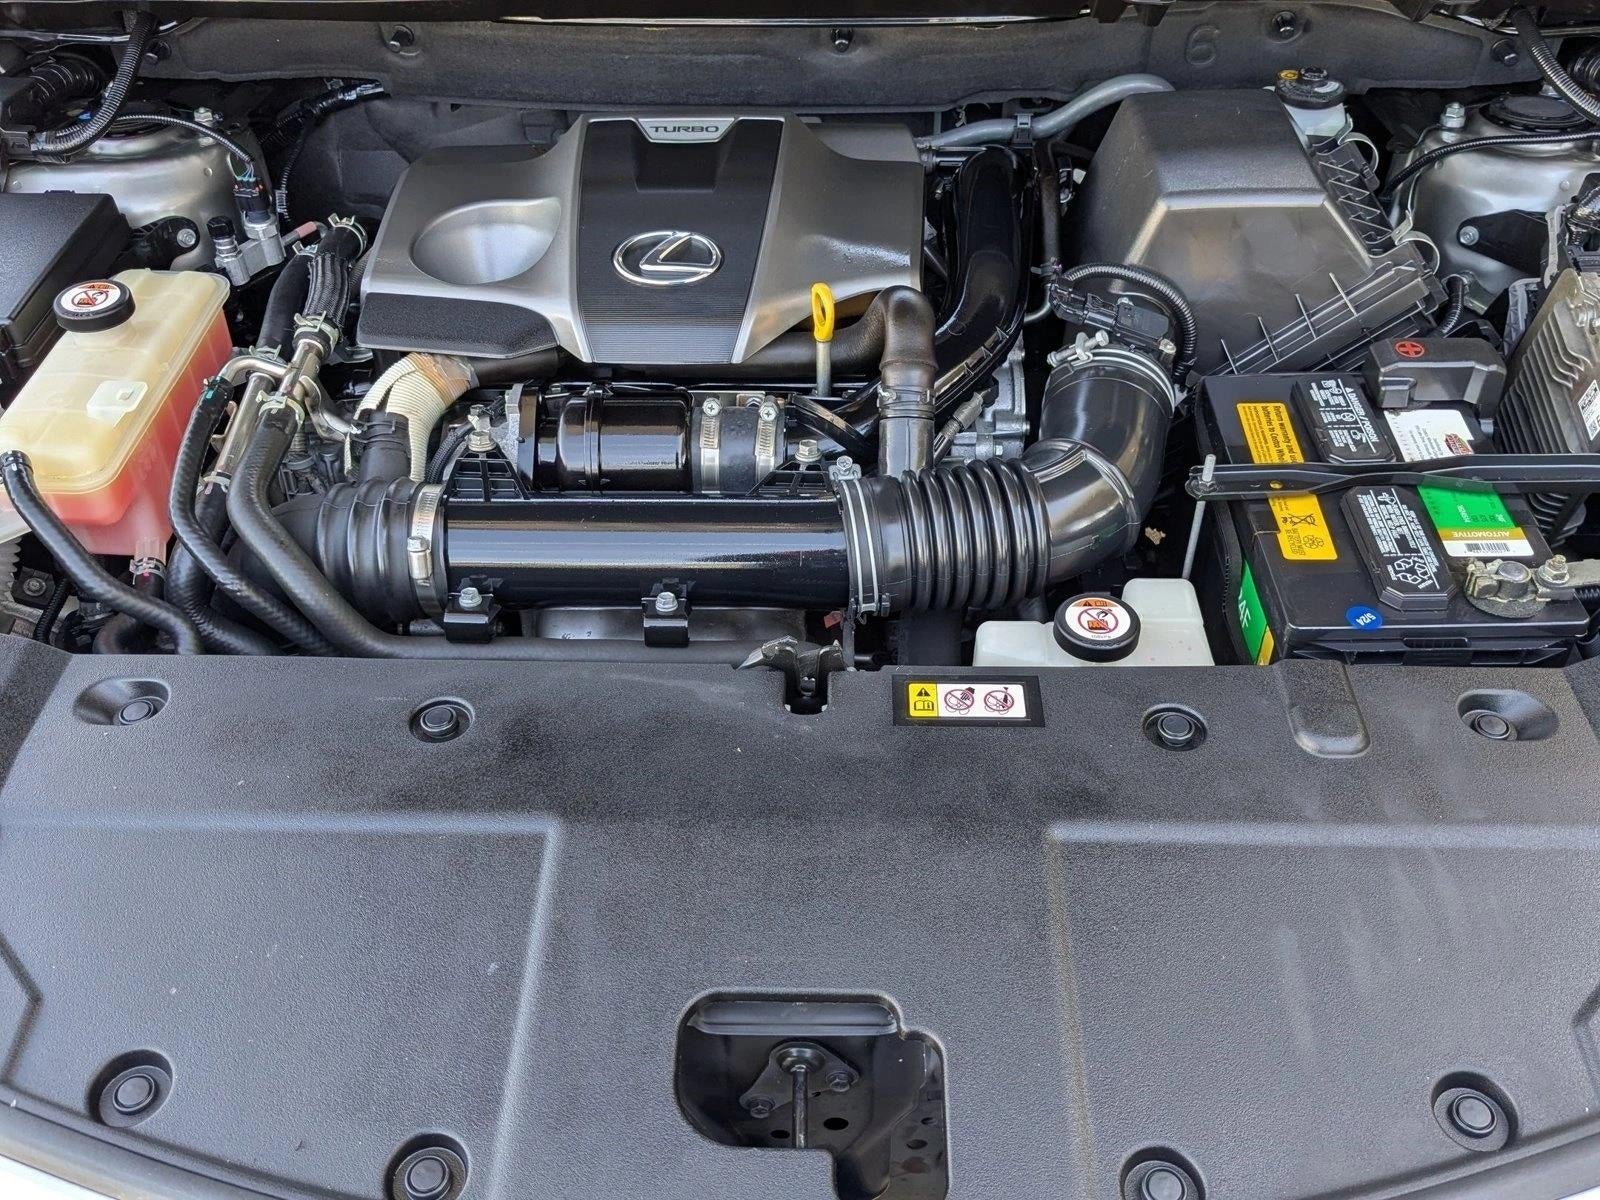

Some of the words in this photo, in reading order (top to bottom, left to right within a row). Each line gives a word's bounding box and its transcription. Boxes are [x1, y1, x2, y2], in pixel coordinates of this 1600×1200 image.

[649, 125, 720, 133] TURBO
[1273, 405, 1284, 421] Return
[1347, 392, 1366, 416] DANGER
[1362, 420, 1379, 442] POISON
[1261, 405, 1273, 427] batteries
[1270, 433, 1280, 449] Costco
[1278, 422, 1291, 444] warranty
[1451, 530, 1510, 538] AUTOMOTIVE
